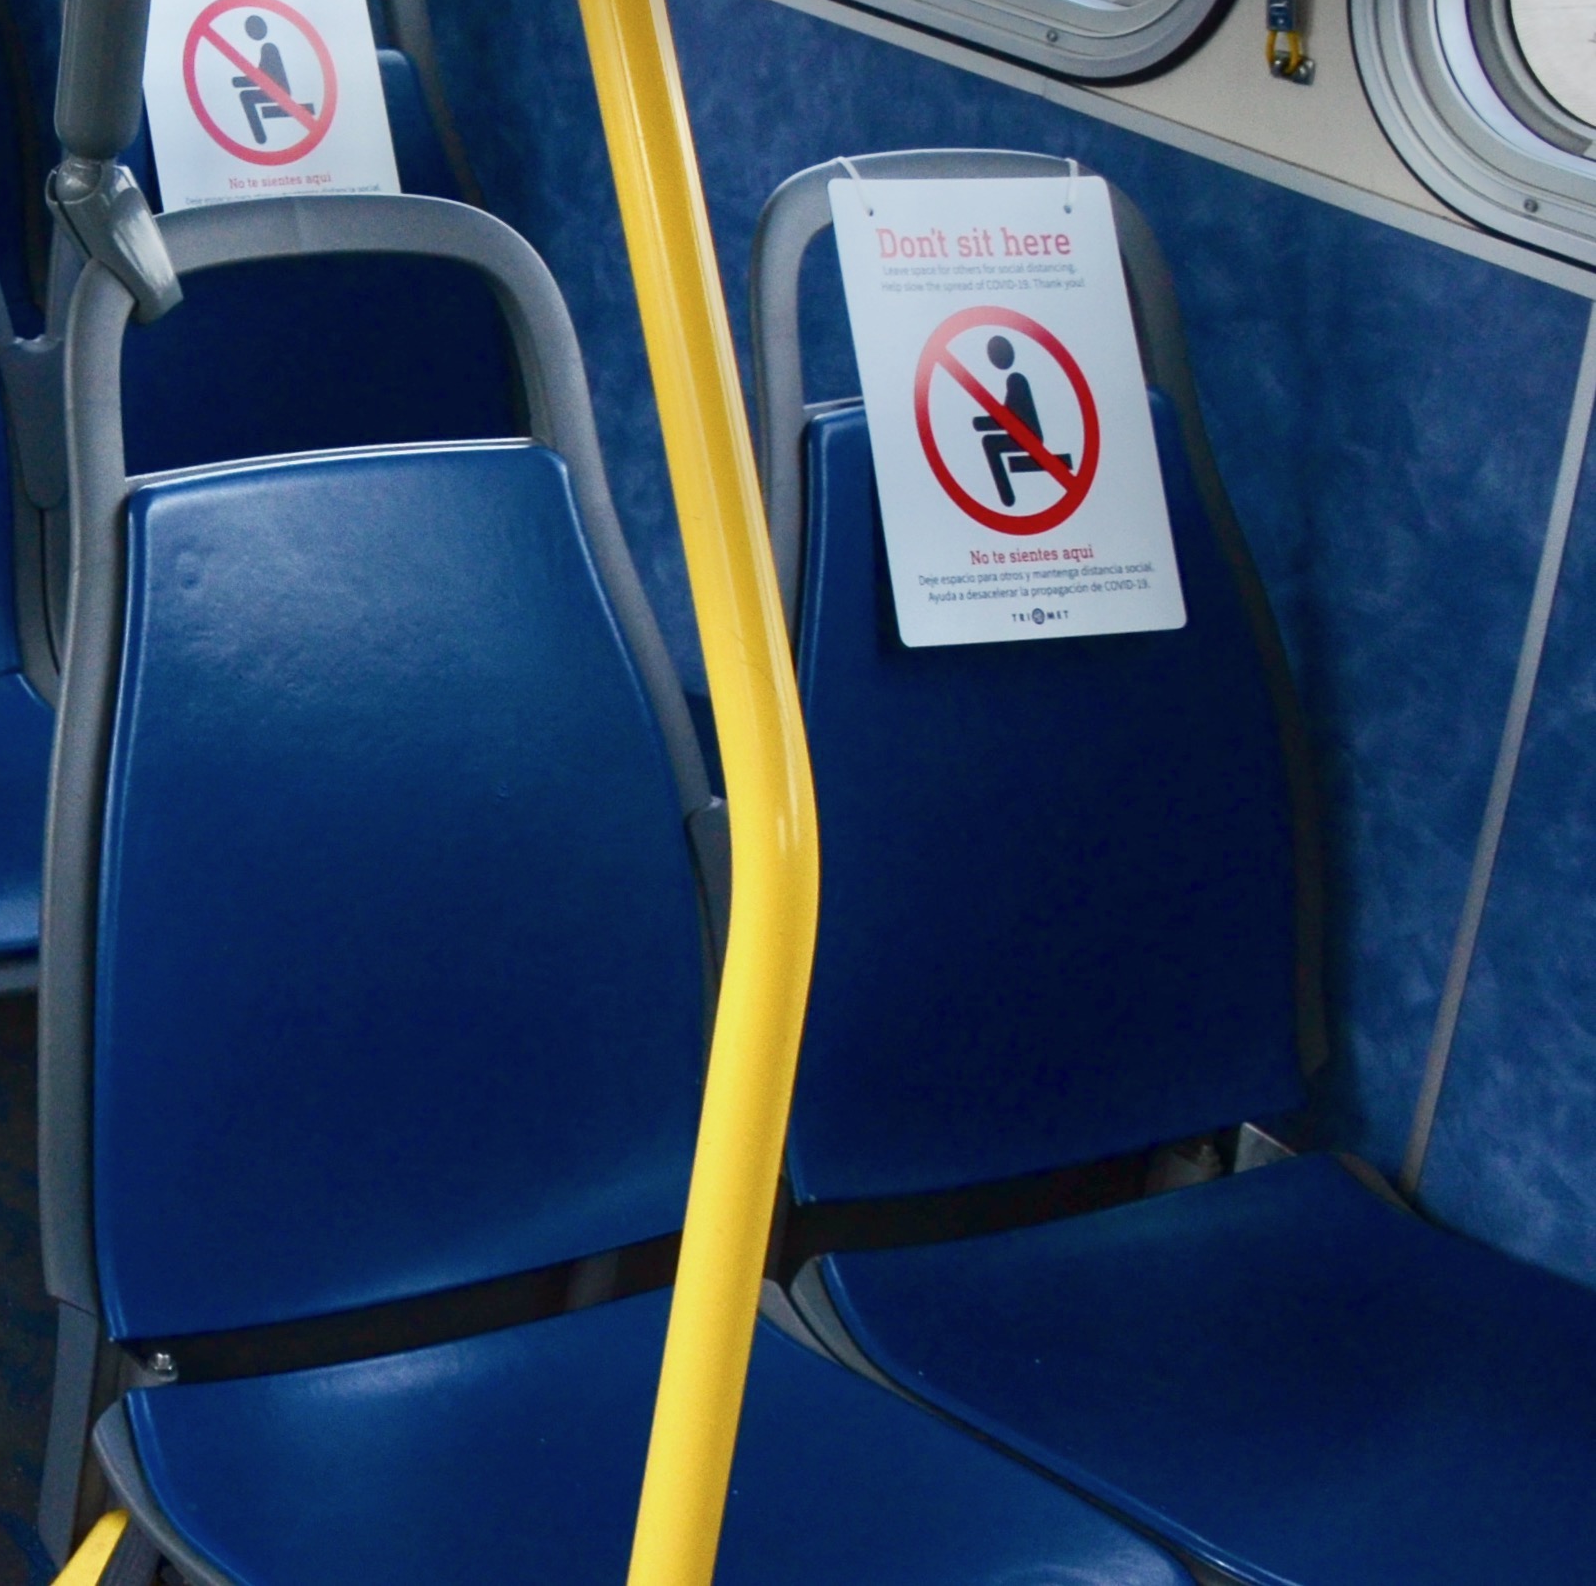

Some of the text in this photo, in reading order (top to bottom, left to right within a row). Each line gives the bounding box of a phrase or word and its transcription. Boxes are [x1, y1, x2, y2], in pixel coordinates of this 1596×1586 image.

[877, 225, 1072, 259] Don't sit here
[969, 549, 990, 565] No
[992, 550, 1007, 564] te
[1009, 548, 1060, 564] sientes
